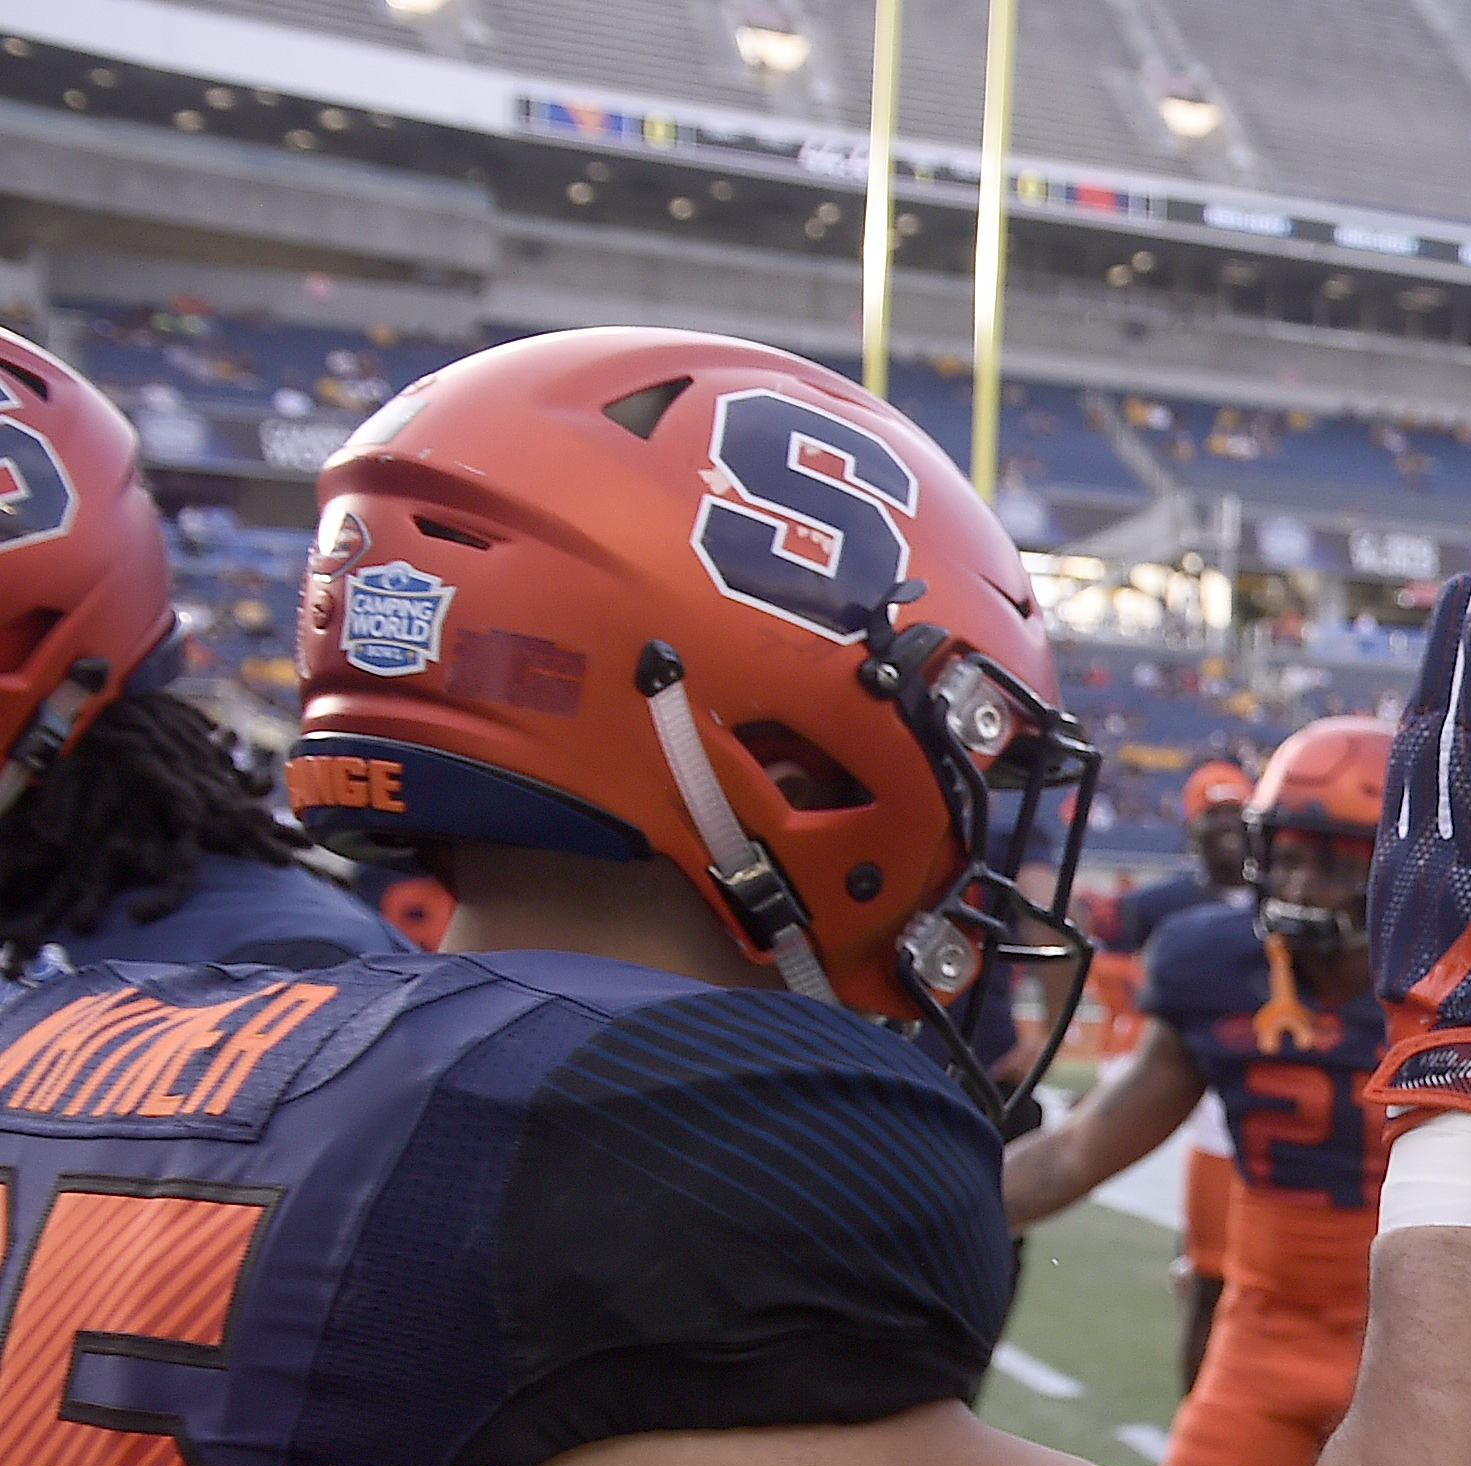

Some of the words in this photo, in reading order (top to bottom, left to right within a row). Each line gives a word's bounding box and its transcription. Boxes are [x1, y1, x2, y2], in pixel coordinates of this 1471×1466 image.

[689, 388, 919, 646] S
[352, 593, 435, 622] CAMPING
[352, 614, 430, 642] WORLD
